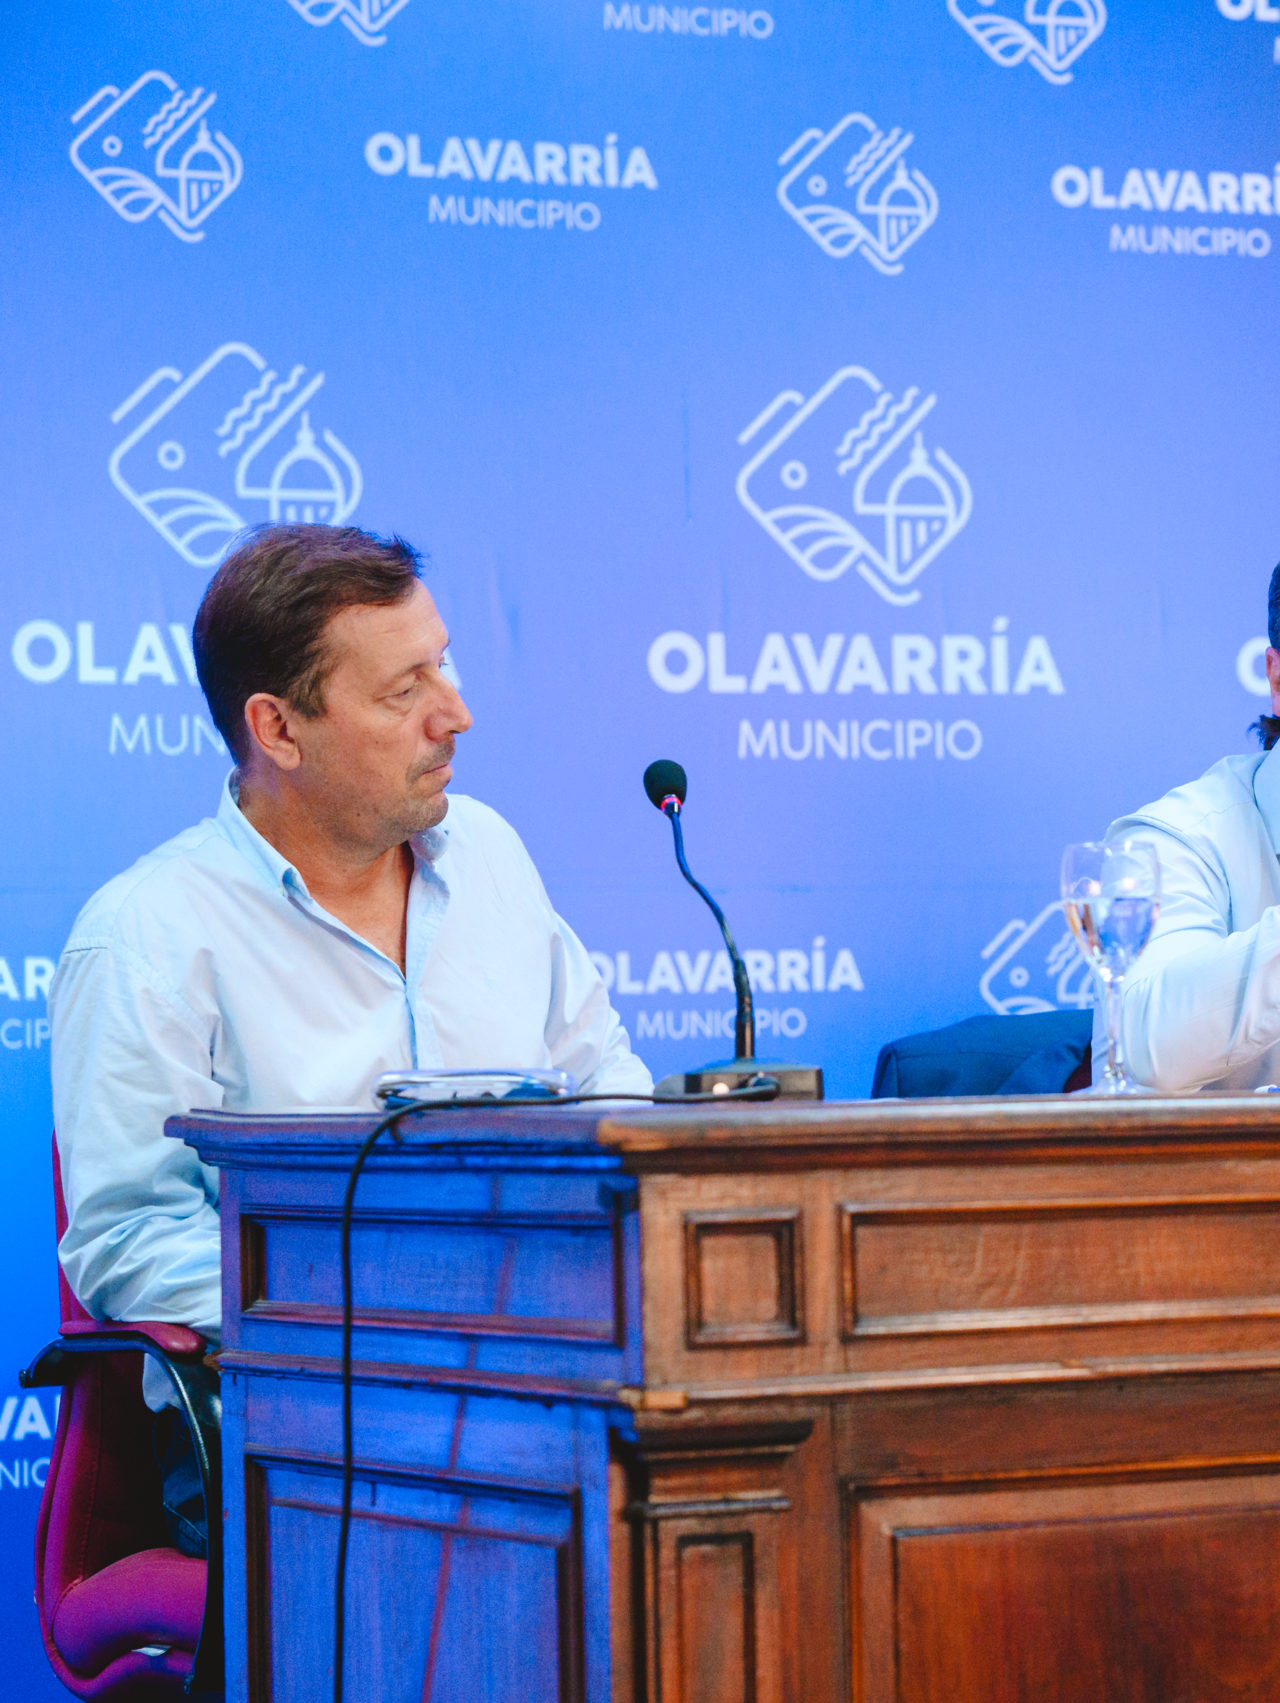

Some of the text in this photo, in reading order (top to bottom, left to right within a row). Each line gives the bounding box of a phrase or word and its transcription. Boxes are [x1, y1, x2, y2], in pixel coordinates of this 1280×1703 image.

[603, 2, 774, 39] MUNICIPIO
[365, 132, 658, 189] OLAVARRÍA
[428, 195, 600, 231] MUNICIPIO
[1109, 224, 1271, 257] MUNICIPIO
[647, 616, 1065, 694] OLAVARRÍA
[738, 719, 982, 760] MUNICIPIO
[637, 1008, 807, 1040] MUNICPIO
